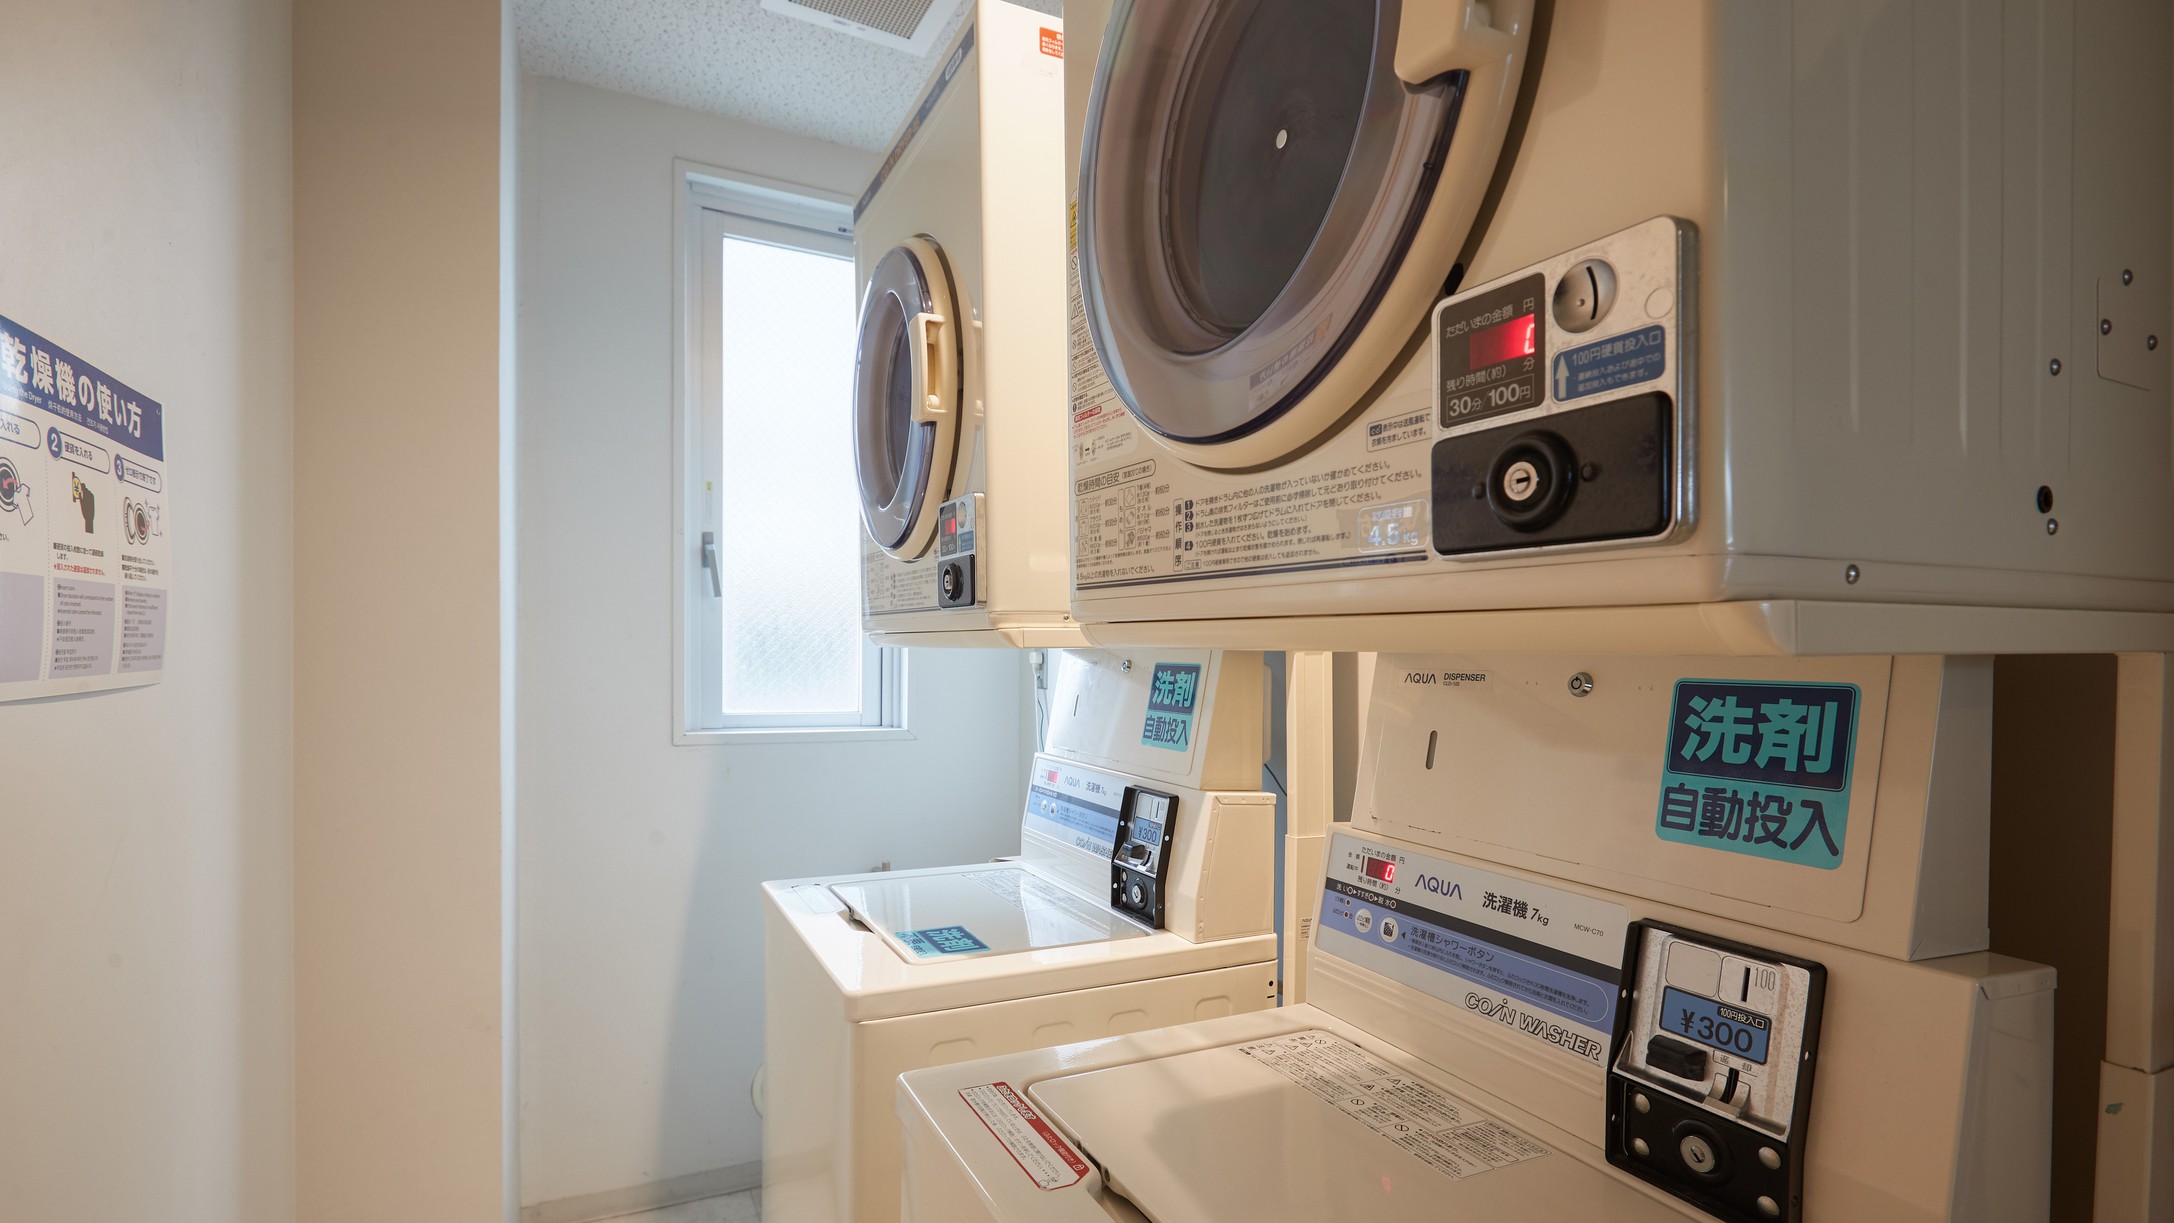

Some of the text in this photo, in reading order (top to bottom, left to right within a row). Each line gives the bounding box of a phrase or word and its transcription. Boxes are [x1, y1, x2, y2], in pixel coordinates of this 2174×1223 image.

[1446, 297, 1534, 338] ただいまの金額 円
[1573, 330, 1661, 366] 100円硬貨投入口
[1, 332, 142, 438] 乾燥機の使い方
[1446, 357, 1535, 392] 残り時間(約) 分
[1449, 383, 1531, 417] 30分/100円
[51, 433, 93, 461] 2 硬貨を入れる
[1077, 472, 1119, 493] 乾燥時間の目安
[1174, 504, 1183, 567] 操作順序
[1368, 523, 1418, 546] 4.5 kg
[1152, 670, 1195, 707] 洗剤
[1404, 672, 1486, 684] AQUA DISPENSER
[1144, 716, 1188, 746] 自動投入
[1680, 695, 1838, 774] 洗剤
[1064, 776, 1080, 788] AQUA
[1138, 826, 1157, 842] ¥300
[1661, 783, 1839, 857] 自動投入
[1361, 846, 1405, 864] ただいまの金額 円
[1384, 864, 1394, 881] 0
[1395, 887, 1401, 895] 分
[1415, 874, 1550, 927] AQUA 洗濯機 7kg
[1411, 926, 1494, 962] 洗濯槽シャワーボタン
[1574, 923, 1604, 937] MCW-C70
[1754, 966, 1776, 991] 100
[1464, 992, 1602, 1061] COIN WASHER
[1681, 1008, 1753, 1053] ¥300
[1720, 1008, 1764, 1029] 100円投入口
